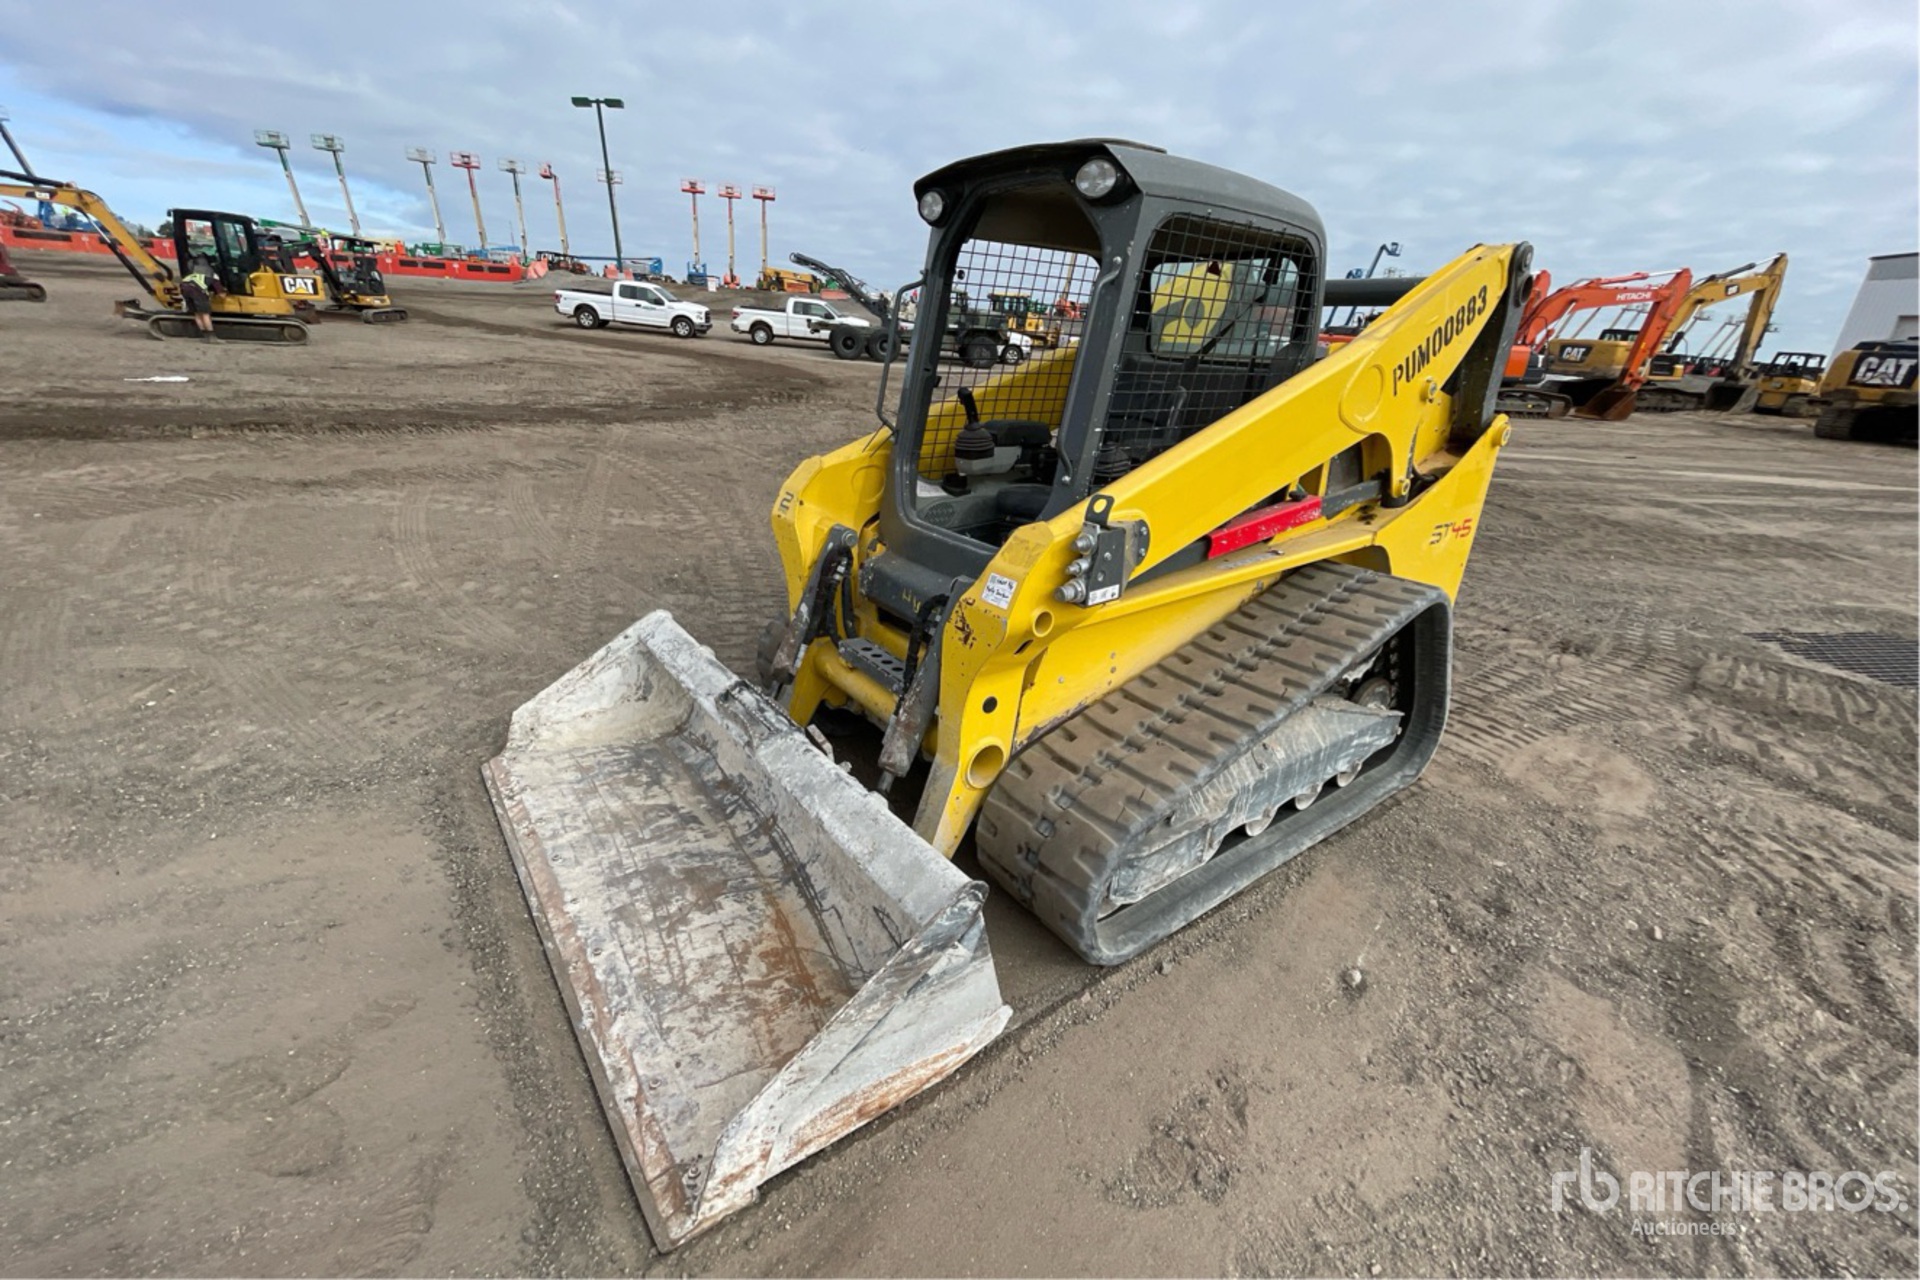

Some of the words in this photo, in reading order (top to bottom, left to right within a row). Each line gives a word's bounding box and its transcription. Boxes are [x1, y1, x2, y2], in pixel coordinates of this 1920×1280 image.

[283, 276, 314, 294] CAT
[1616, 291, 1652, 301] HITACHI
[1393, 285, 1487, 397] PUM00883
[1562, 346, 1587, 361] CAT
[1854, 356, 1918, 386] CAT
